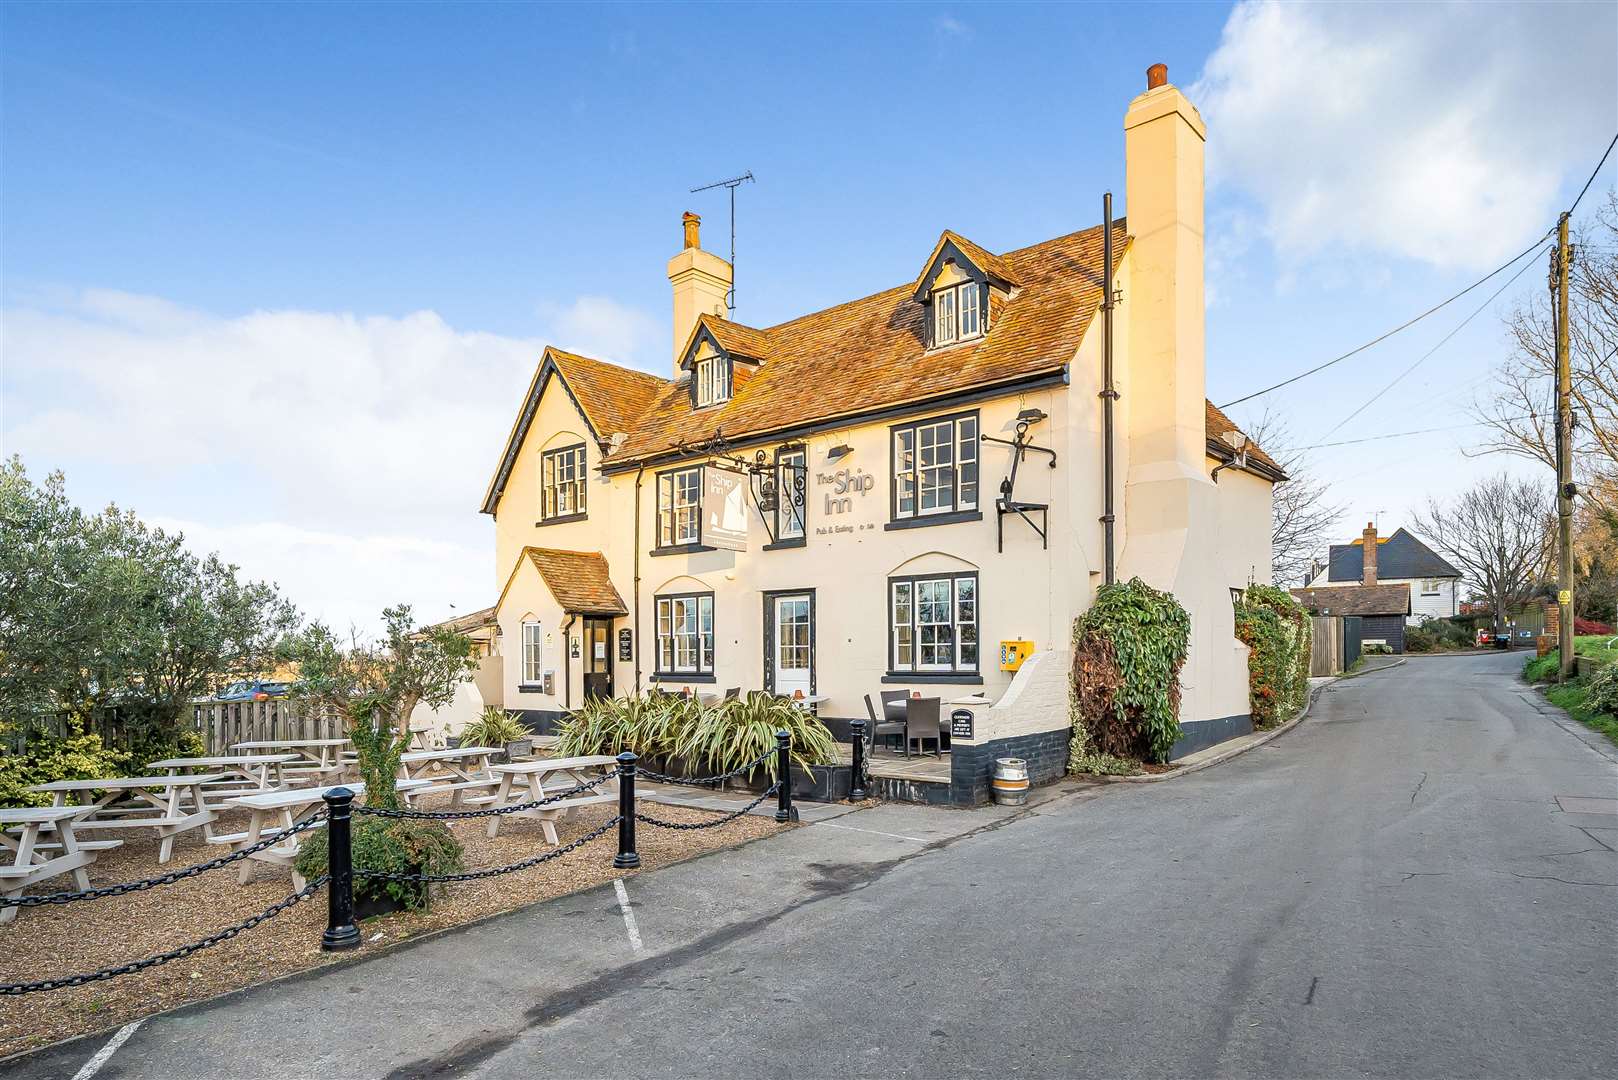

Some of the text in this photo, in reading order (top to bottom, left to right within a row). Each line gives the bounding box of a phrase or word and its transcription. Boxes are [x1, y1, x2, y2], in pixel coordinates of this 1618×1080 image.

[715, 473, 733, 489] Ship
[816, 468, 874, 496] The Ship
[824, 493, 852, 515] Inn
